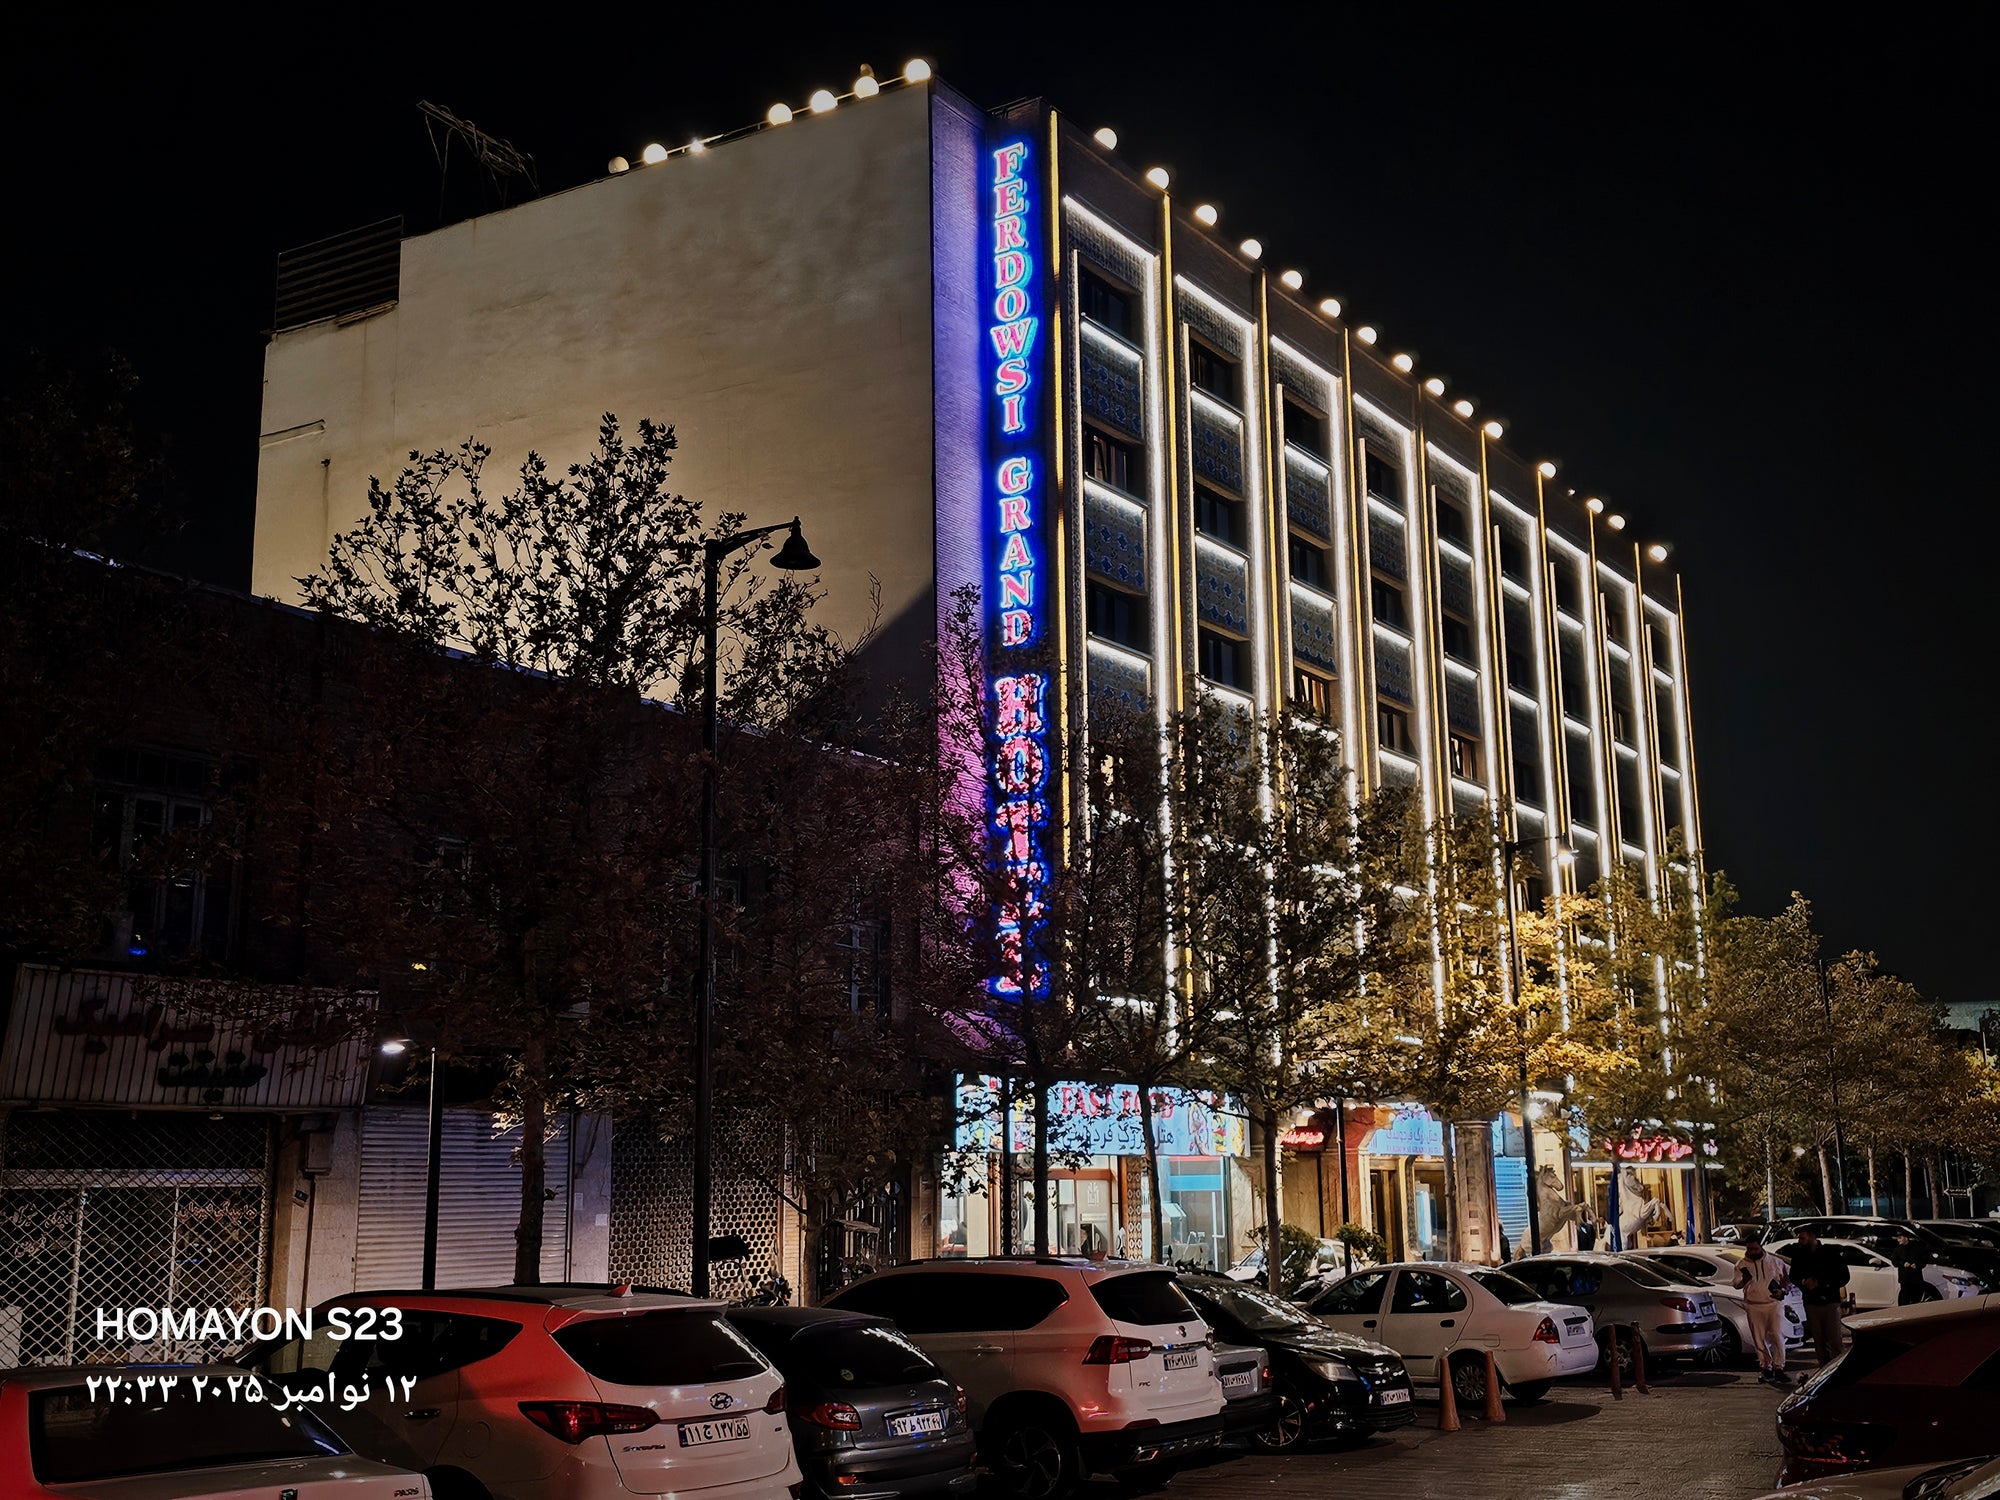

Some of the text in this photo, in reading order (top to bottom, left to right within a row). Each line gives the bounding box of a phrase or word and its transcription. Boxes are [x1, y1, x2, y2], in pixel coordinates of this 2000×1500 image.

[991, 141, 1038, 433] FERDOWSI
[999, 456, 1033, 647] GRAND
[1155, 1125, 1174, 1149] هتل
